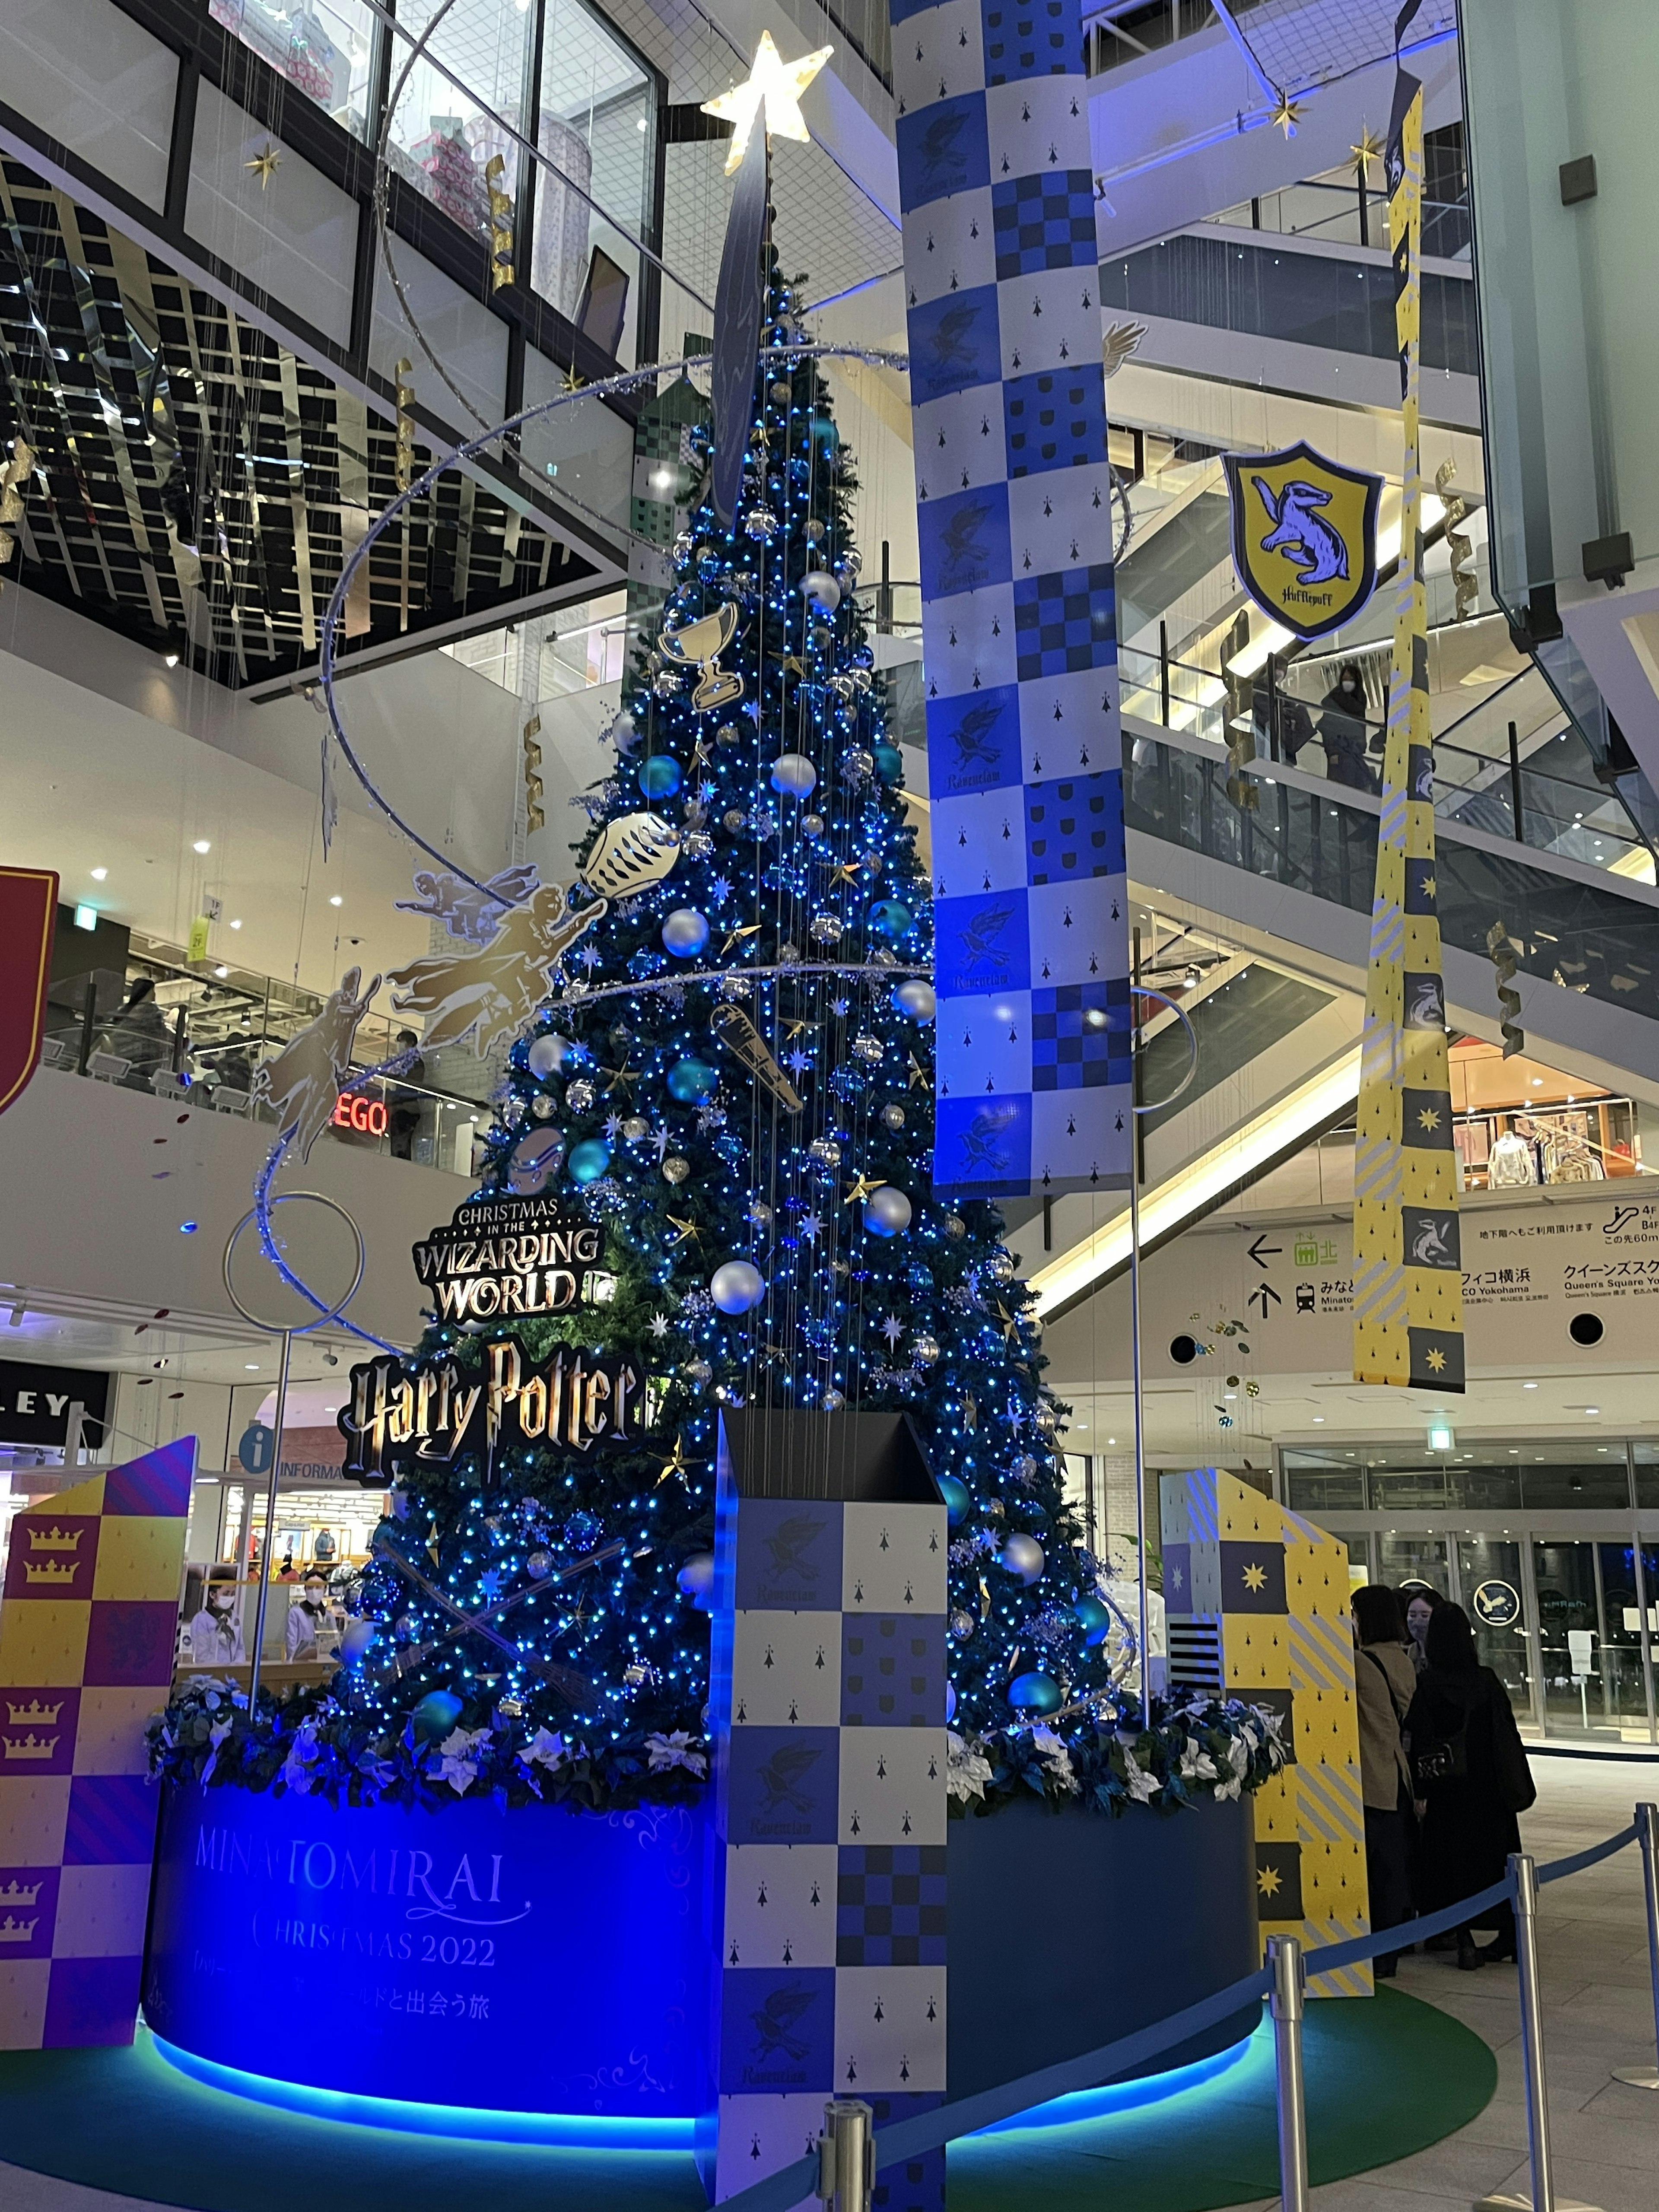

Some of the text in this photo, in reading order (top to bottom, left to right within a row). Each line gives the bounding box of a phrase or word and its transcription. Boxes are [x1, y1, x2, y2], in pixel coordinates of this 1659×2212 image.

[1282, 585, 1333, 607] Hufflepuff
[947, 770, 1000, 791] Ravenclaw
[952, 973, 1008, 991] Ravenclaw
[334, 1092, 387, 1136] EGO
[458, 1198, 558, 1226] CHRISTMAS
[1642, 1205, 1657, 1215] 4F
[487, 1220, 524, 1235] IN THE
[1480, 1223, 1593, 1239] 地下階へもご利用頂けます
[1642, 1220, 1659, 1230] B4F
[1319, 1239, 1338, 1259] 北
[1605, 1233, 1659, 1245] この先60m
[416, 1228, 599, 1279] WIZARDING
[1564, 1260, 1659, 1279] クイーンズスク
[1479, 1285, 1529, 1295] Yokohama
[1564, 1281, 1604, 1290] Queen's
[1607, 1279, 1644, 1289] Square
[435, 1270, 576, 1320] WORLD
[0, 1391, 69, 1417] EY
[343, 1341, 637, 1484] Harry Potter
[421, 1934, 496, 1967] 2022
